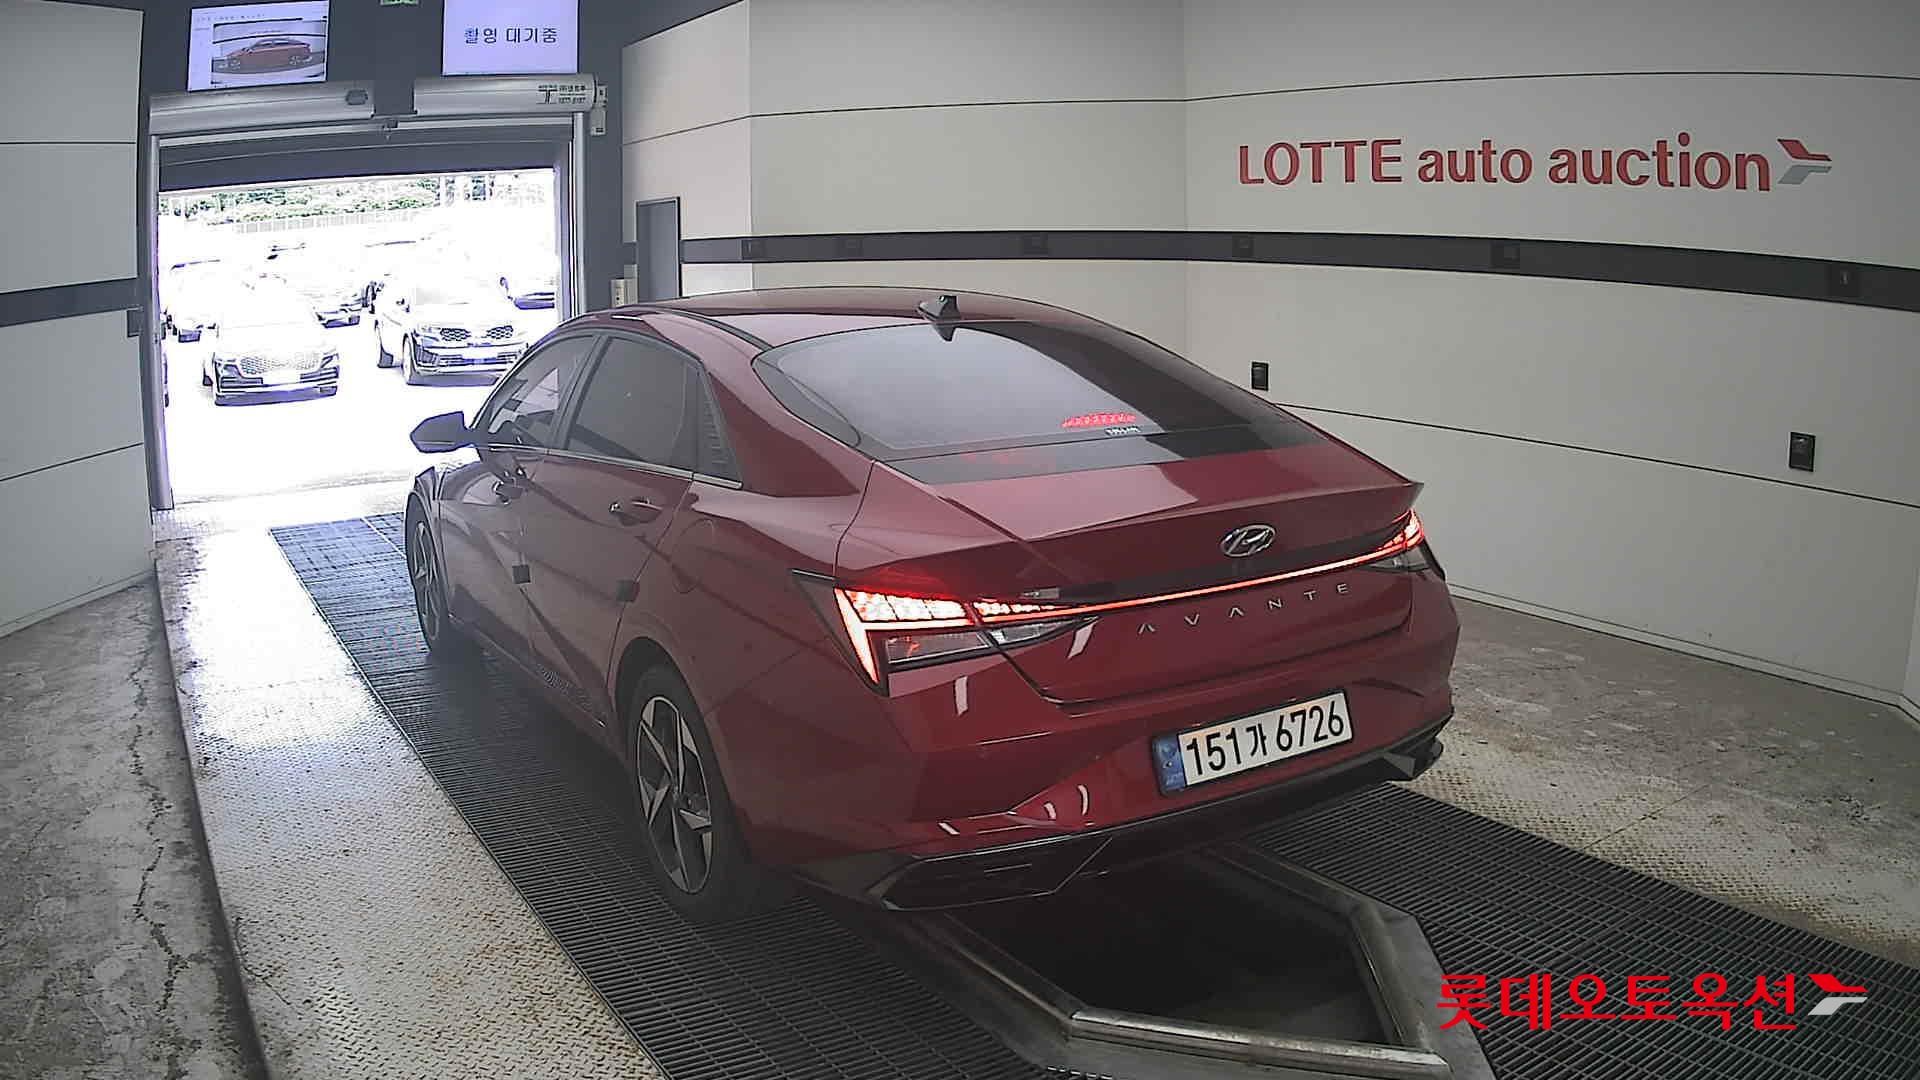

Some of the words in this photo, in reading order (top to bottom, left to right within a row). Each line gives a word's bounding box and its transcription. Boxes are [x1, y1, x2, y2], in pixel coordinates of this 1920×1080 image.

[506, 27, 558, 44] 대기중
[1238, 138, 1403, 186] LOTTE
[1417, 139, 1534, 184] auto
[1547, 131, 1771, 192] auction
[1137, 582, 1350, 635] AVANTE
